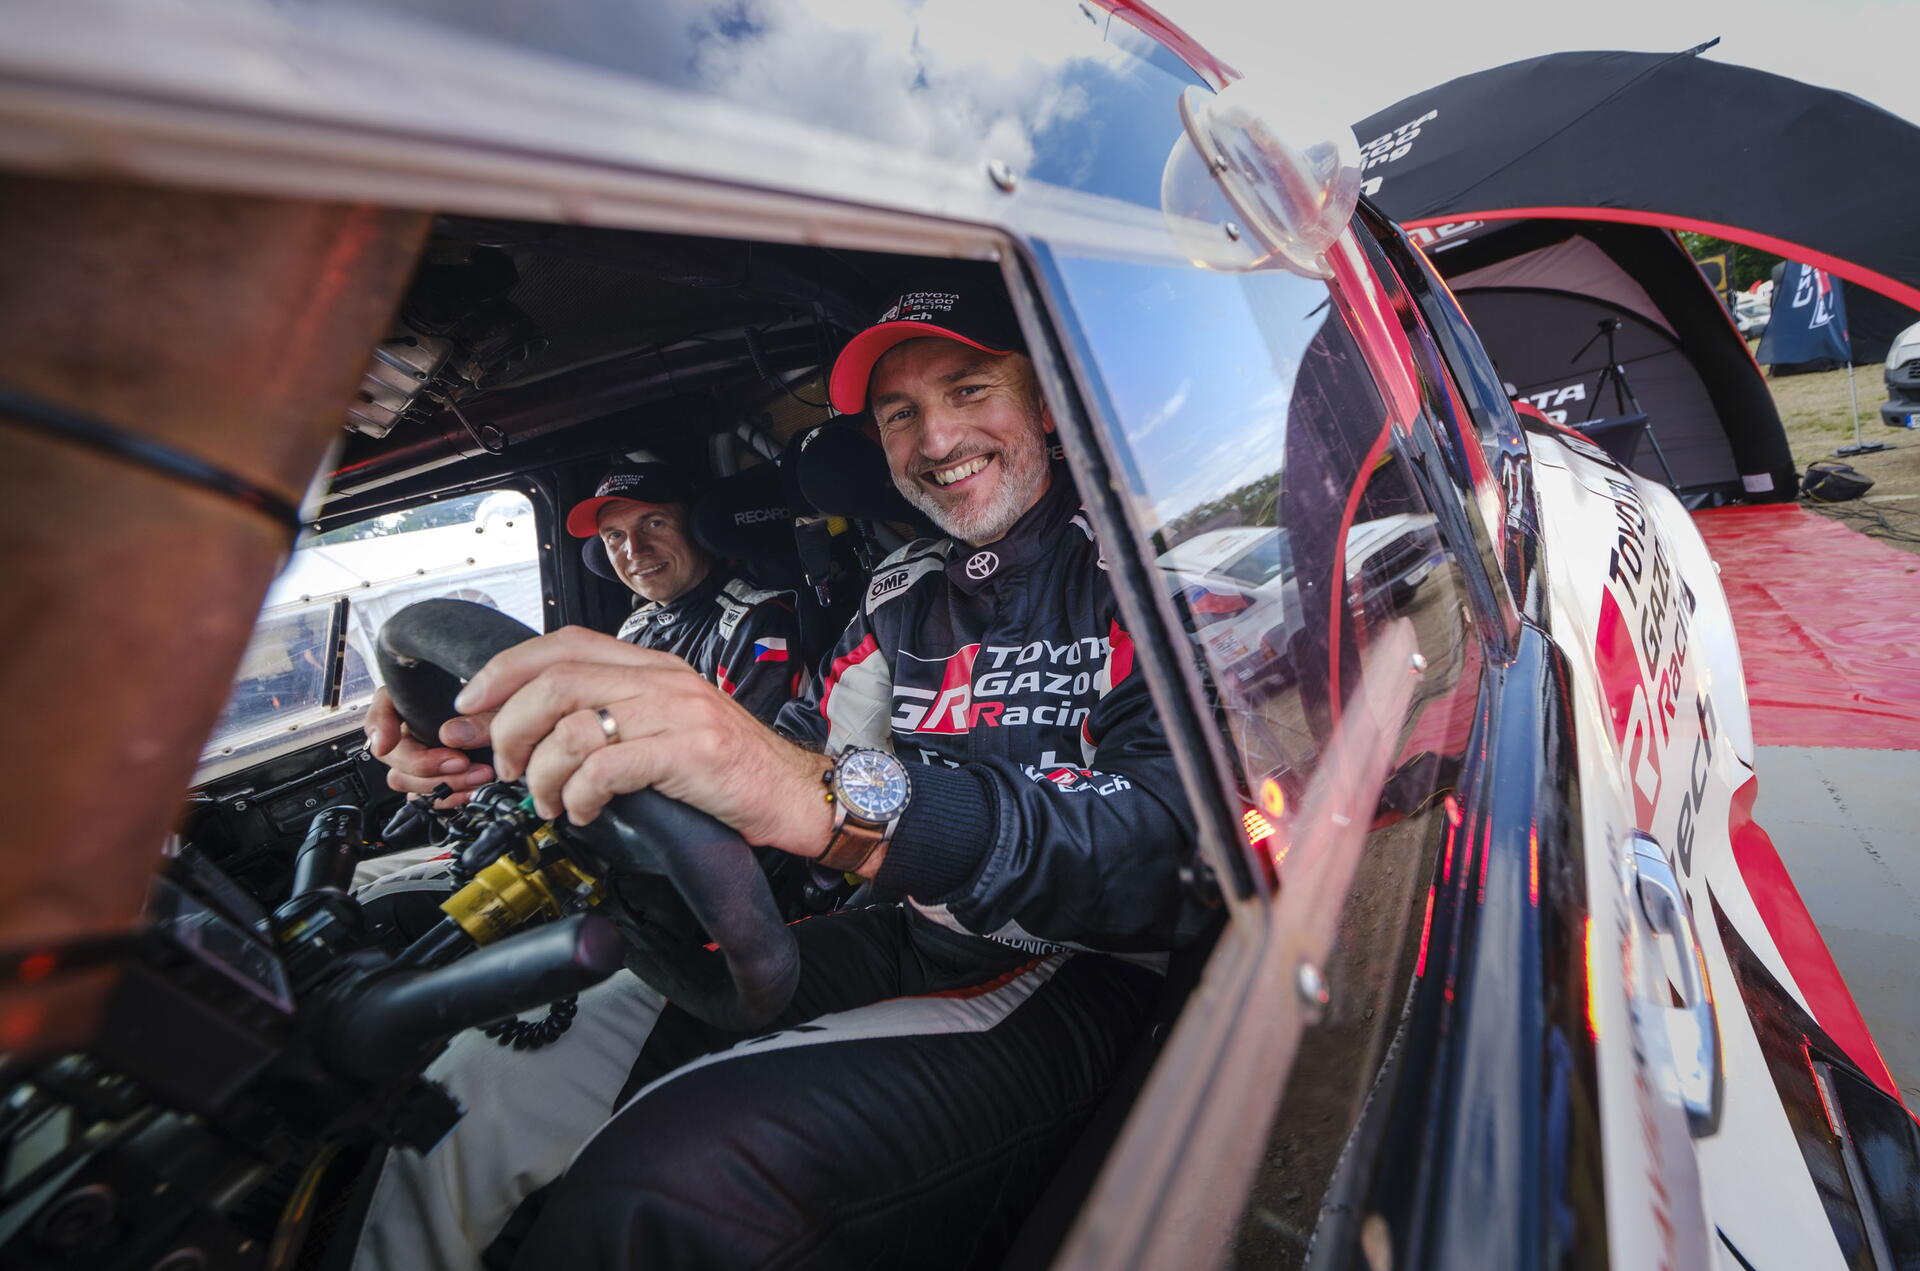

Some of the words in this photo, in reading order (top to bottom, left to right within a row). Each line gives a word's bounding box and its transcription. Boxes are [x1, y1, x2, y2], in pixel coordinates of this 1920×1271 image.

[903, 298, 954, 307] GAZOO
[906, 292, 960, 300] TOYOTA
[1518, 383, 1586, 410] TA
[734, 508, 791, 526] RECARO
[1604, 477, 1646, 611] TOYOTA
[872, 572, 909, 596] OMP
[1641, 535, 1670, 682] GAZO
[891, 684, 970, 731] GR
[968, 700, 1091, 728] Racin
[1670, 691, 1718, 879] ech
